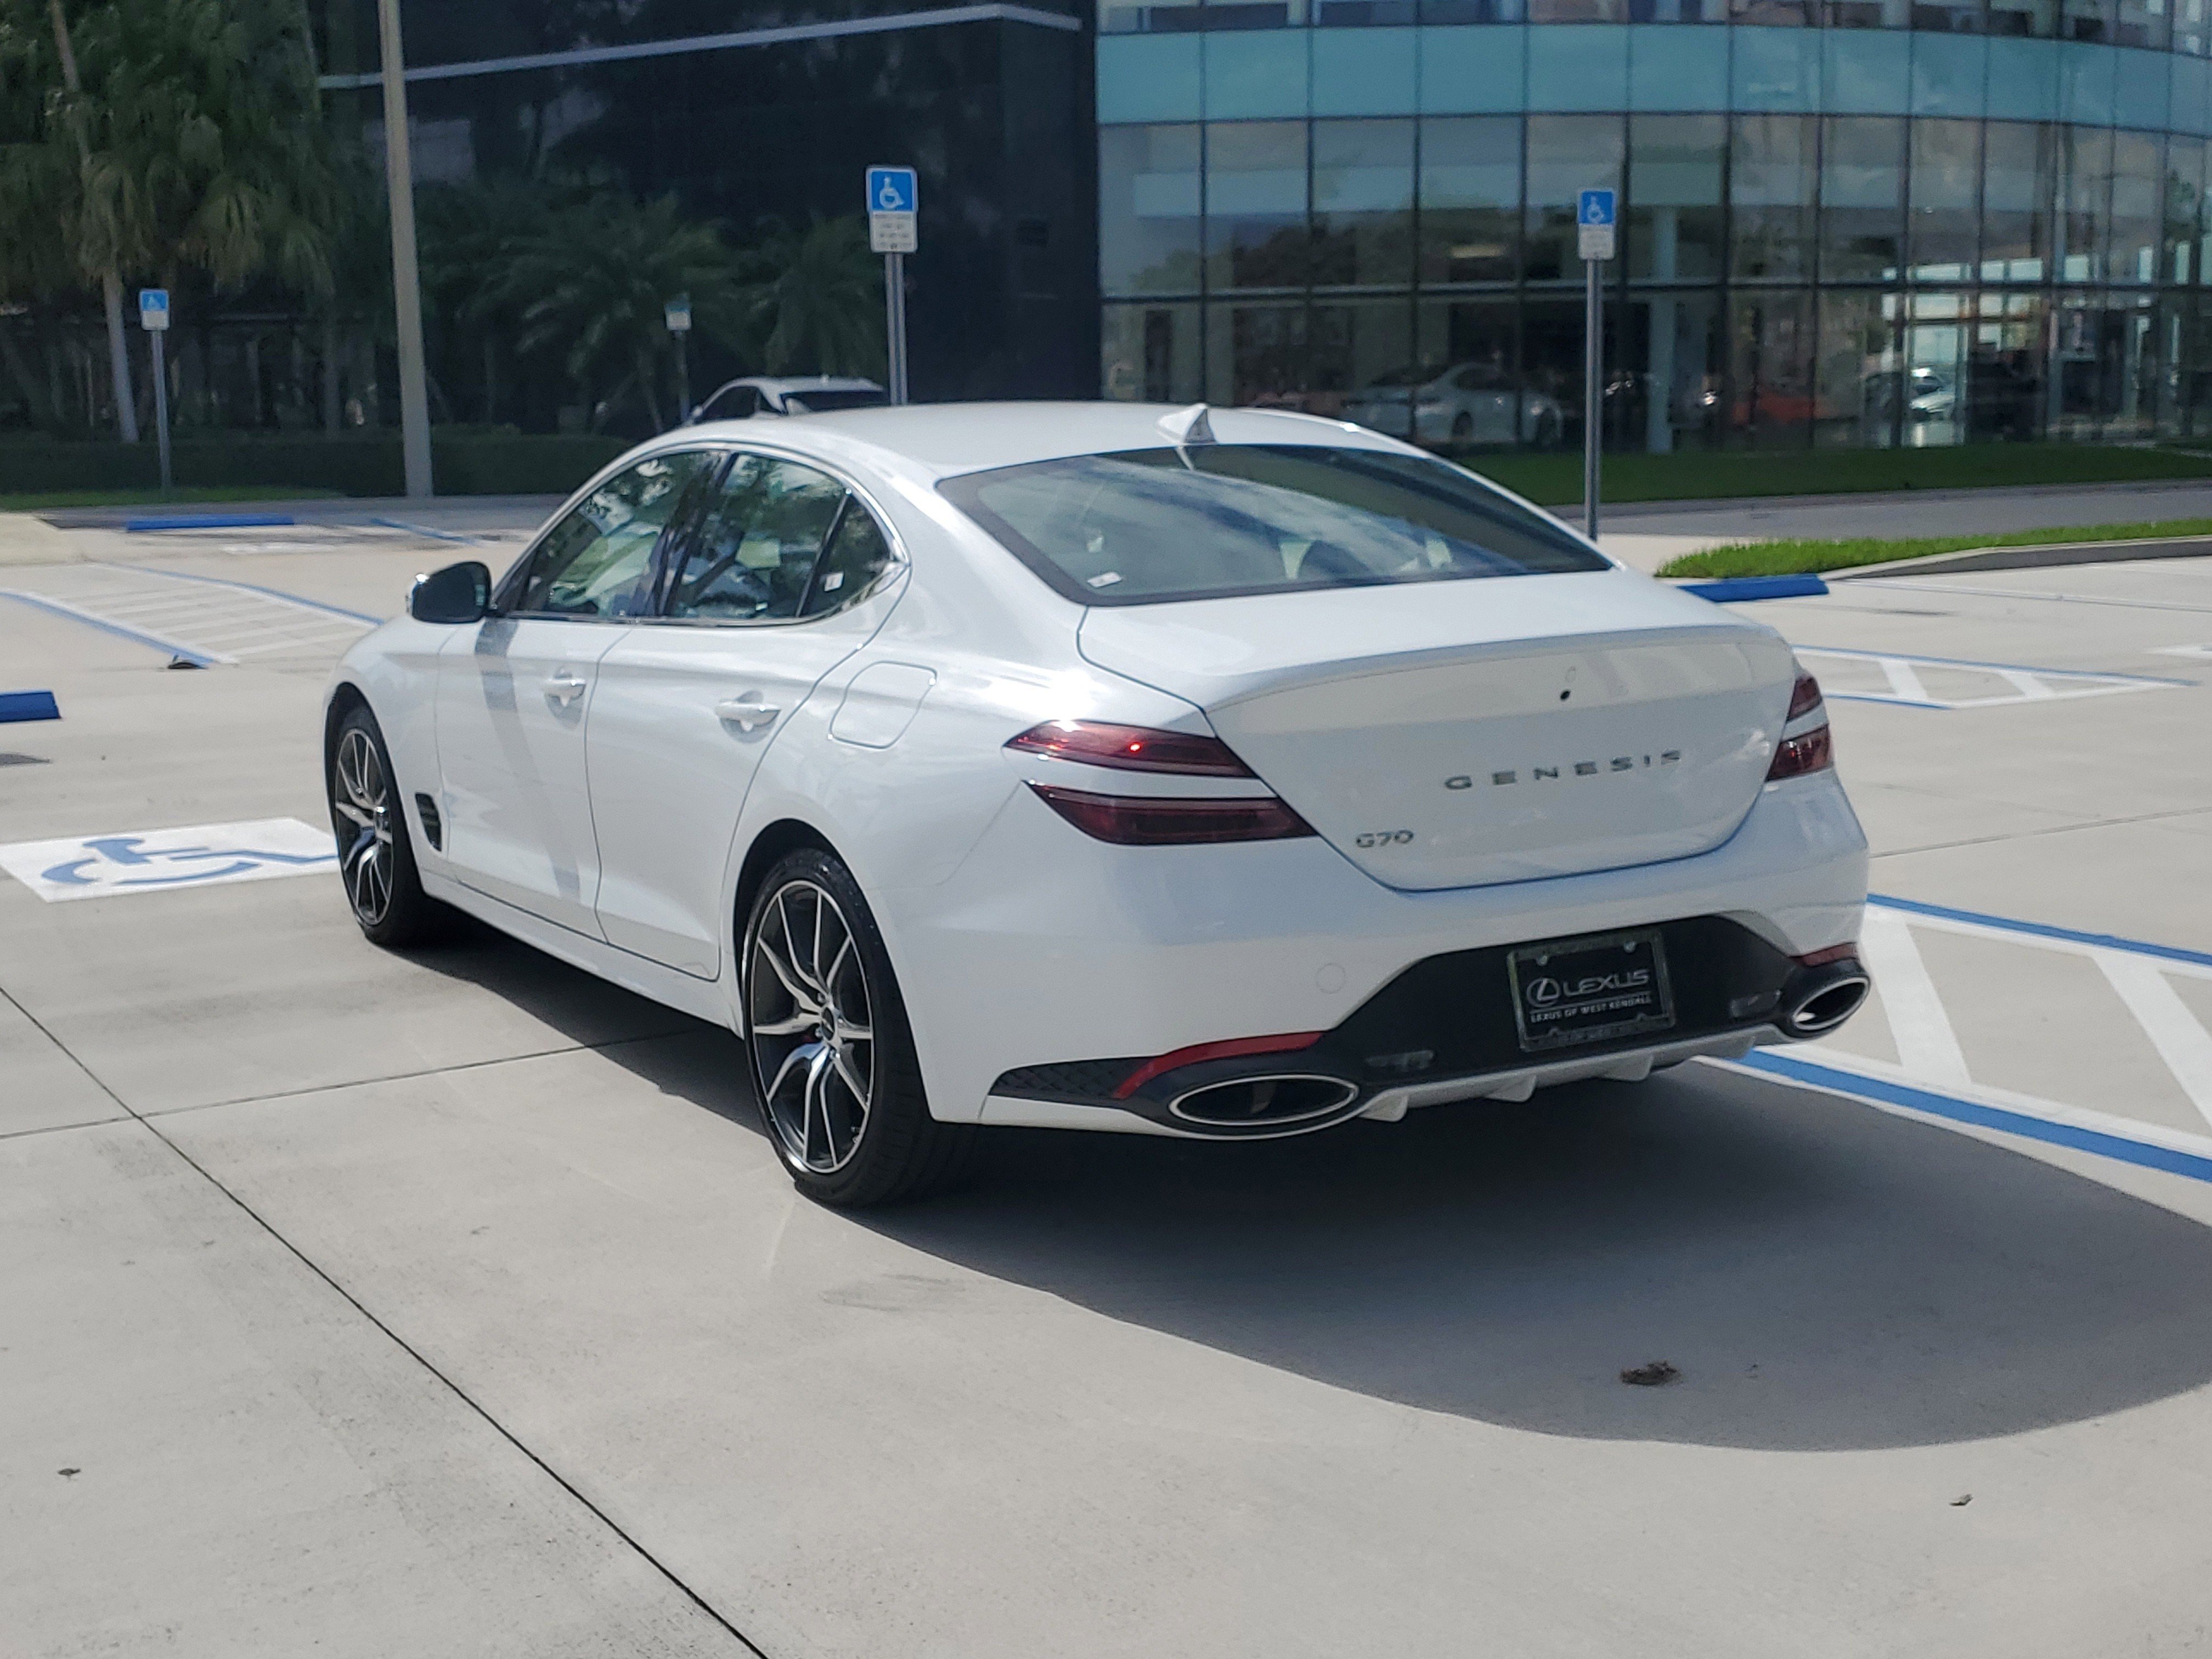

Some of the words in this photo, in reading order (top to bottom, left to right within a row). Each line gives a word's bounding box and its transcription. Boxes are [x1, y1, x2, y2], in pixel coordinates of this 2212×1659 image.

[1444, 750, 1681, 790] GENESIS
[1356, 830, 1414, 848] G70
[1564, 969, 1649, 996] LEXUS
[1531, 1011, 1561, 1023] LEXUS
[1565, 1007, 1578, 1016] OF
[1581, 1002, 1607, 1014] WEST
